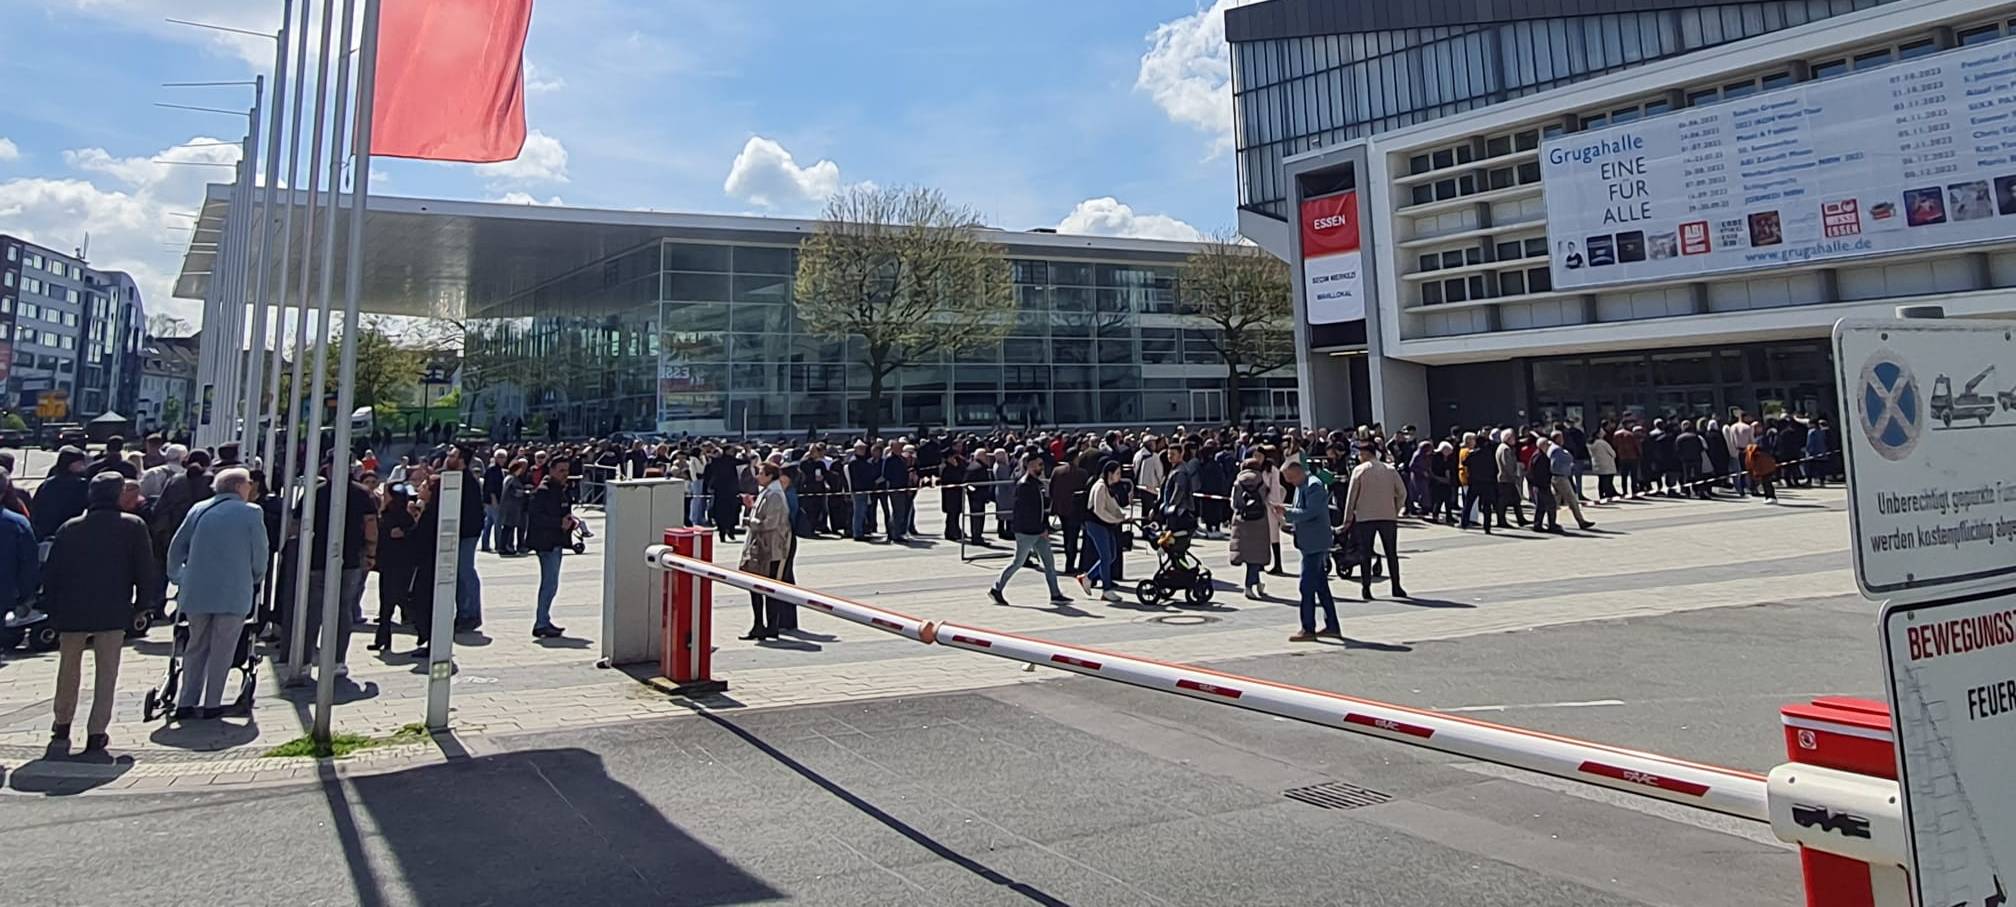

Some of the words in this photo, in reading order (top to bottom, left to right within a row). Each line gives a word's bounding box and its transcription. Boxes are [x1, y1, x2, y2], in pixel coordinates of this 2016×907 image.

[1549, 133, 1645, 166] Grugahalle
[1601, 156, 1648, 181] EINE
[1608, 179, 1649, 202] FÜR
[1313, 214, 1346, 231] ESSEN
[1603, 201, 1652, 225] ALLE
[1745, 238, 1872, 262] www.grugahalle.de
[1877, 489, 1950, 515] Unberechtigt
[1870, 527, 1915, 553] werden
[1907, 609, 2016, 661] BEWEGUNGS
